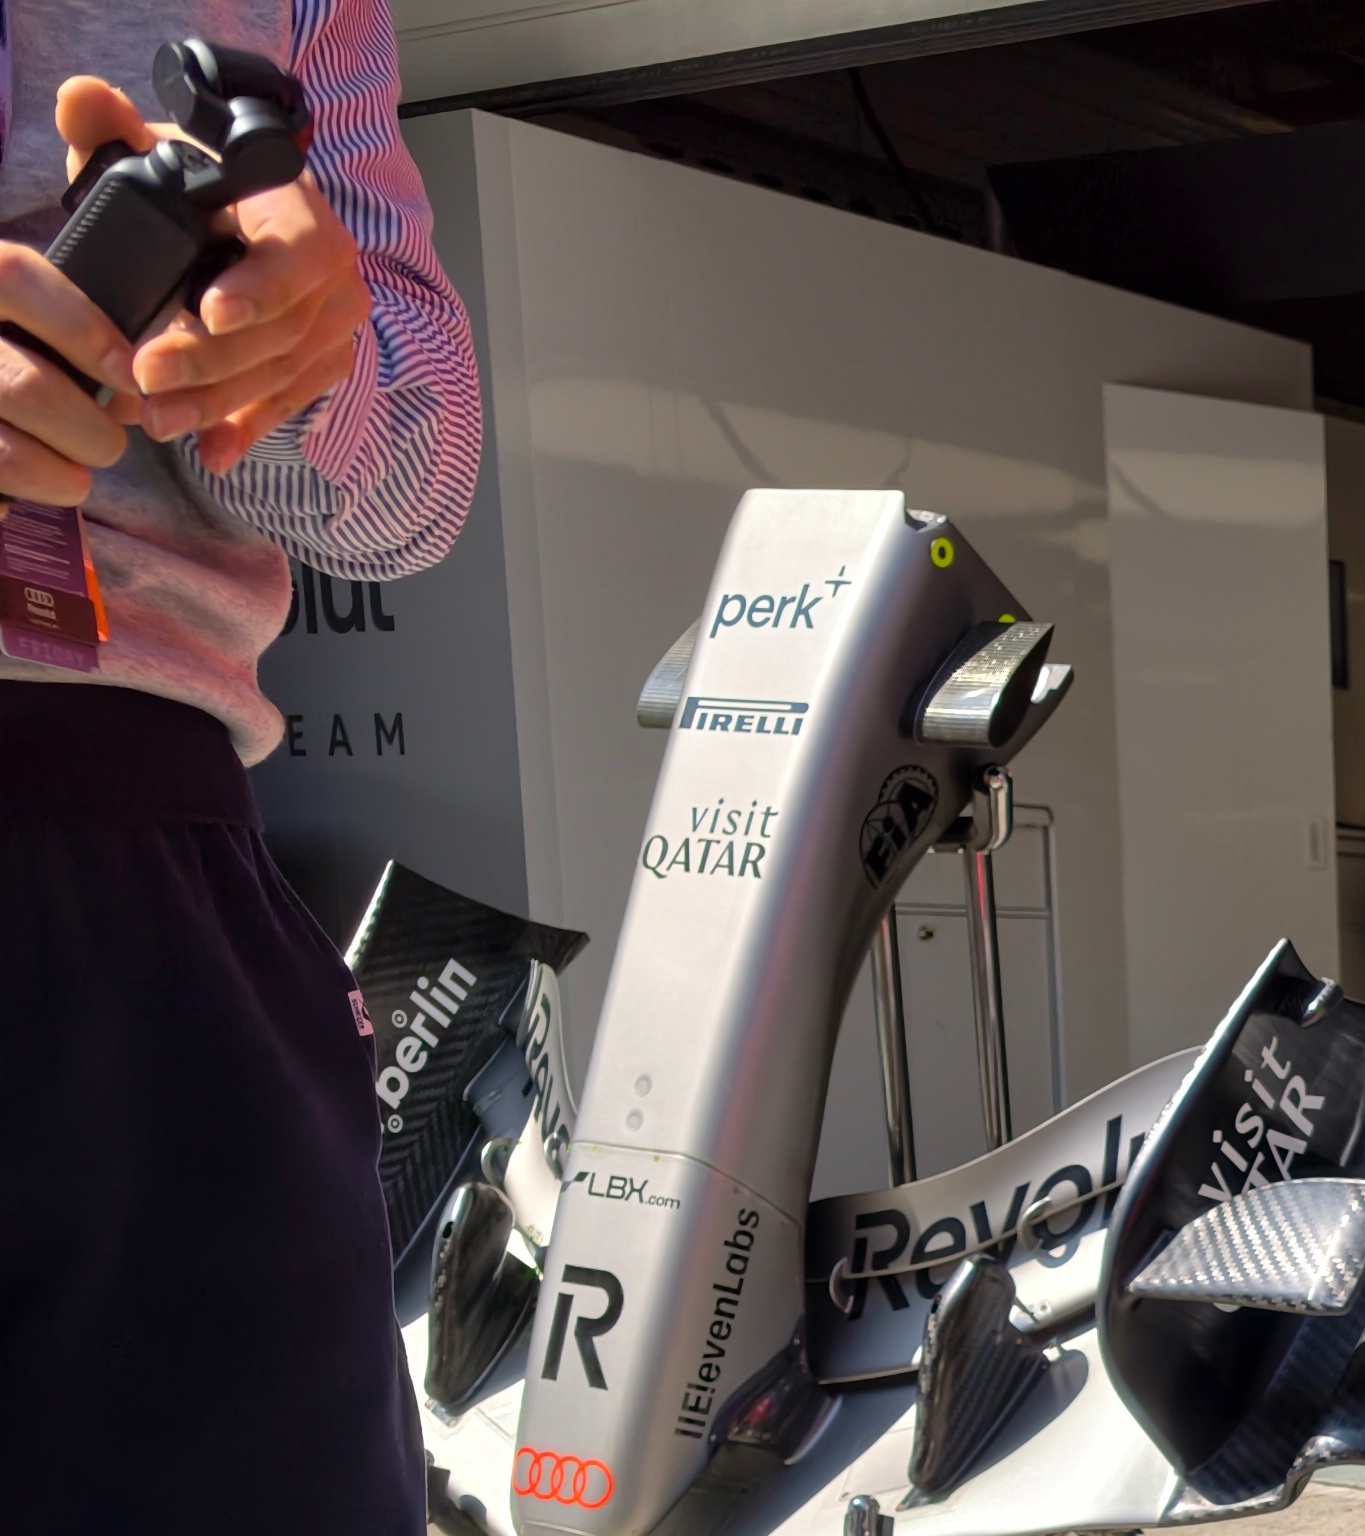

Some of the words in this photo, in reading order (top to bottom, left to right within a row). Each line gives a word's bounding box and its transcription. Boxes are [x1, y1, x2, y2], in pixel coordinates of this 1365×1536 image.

[286, 712, 406, 758] EAM
[678, 696, 809, 736] PIRELLI
[690, 797, 779, 840] visit
[641, 834, 767, 880] QATAR
[375, 957, 478, 1110] berlin
[1197, 1035, 1293, 1202] visit
[541, 1263, 625, 1391] R
